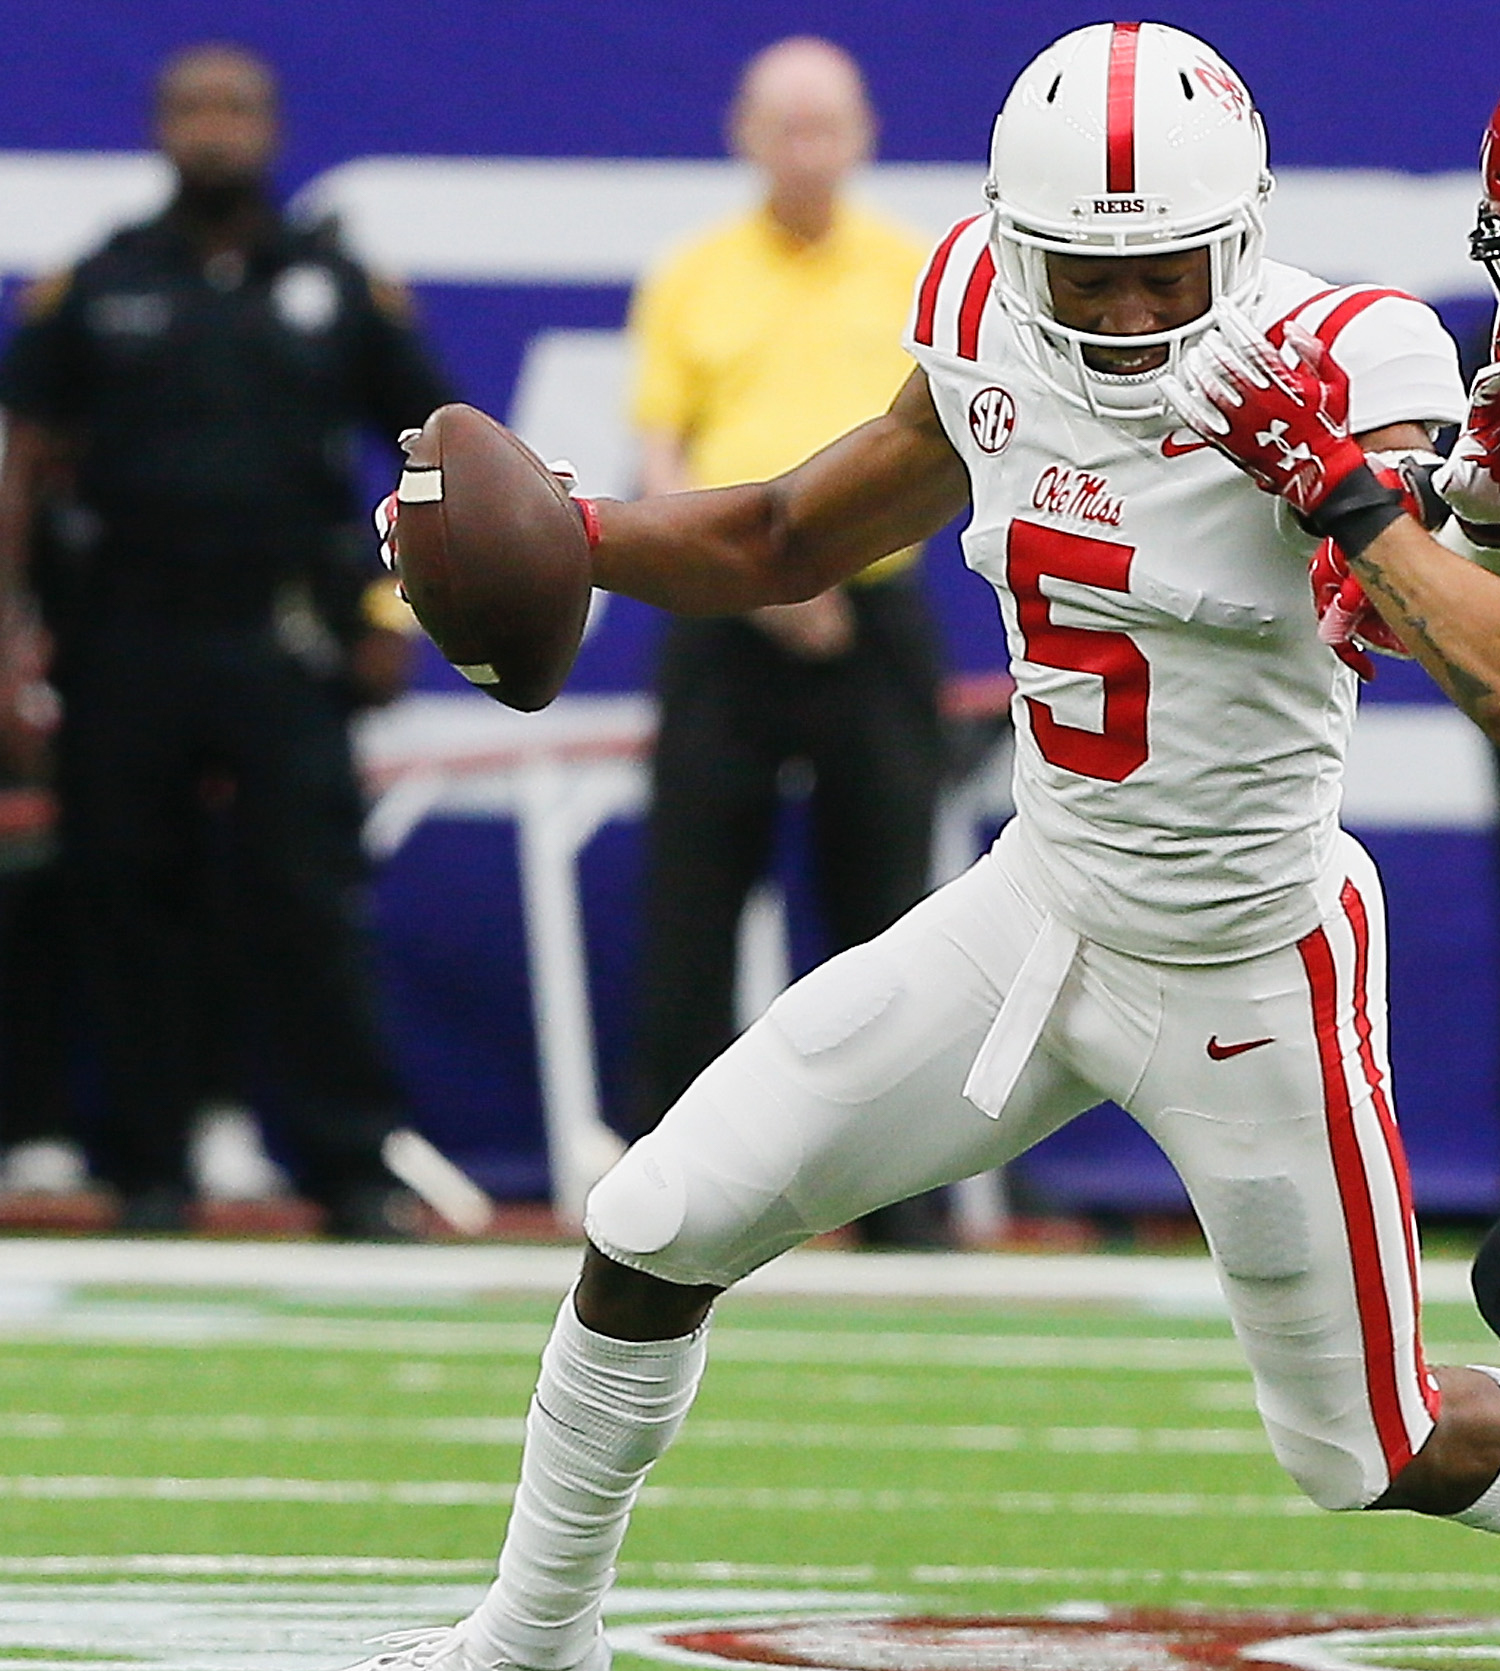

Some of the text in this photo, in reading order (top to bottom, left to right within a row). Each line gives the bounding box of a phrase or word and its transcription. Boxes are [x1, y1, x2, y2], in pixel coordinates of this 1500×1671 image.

[1093, 199, 1145, 214] REBS
[971, 386, 1016, 452] SEC
[1033, 465, 1126, 527] Ole Miss
[1006, 517, 1152, 784] 5
